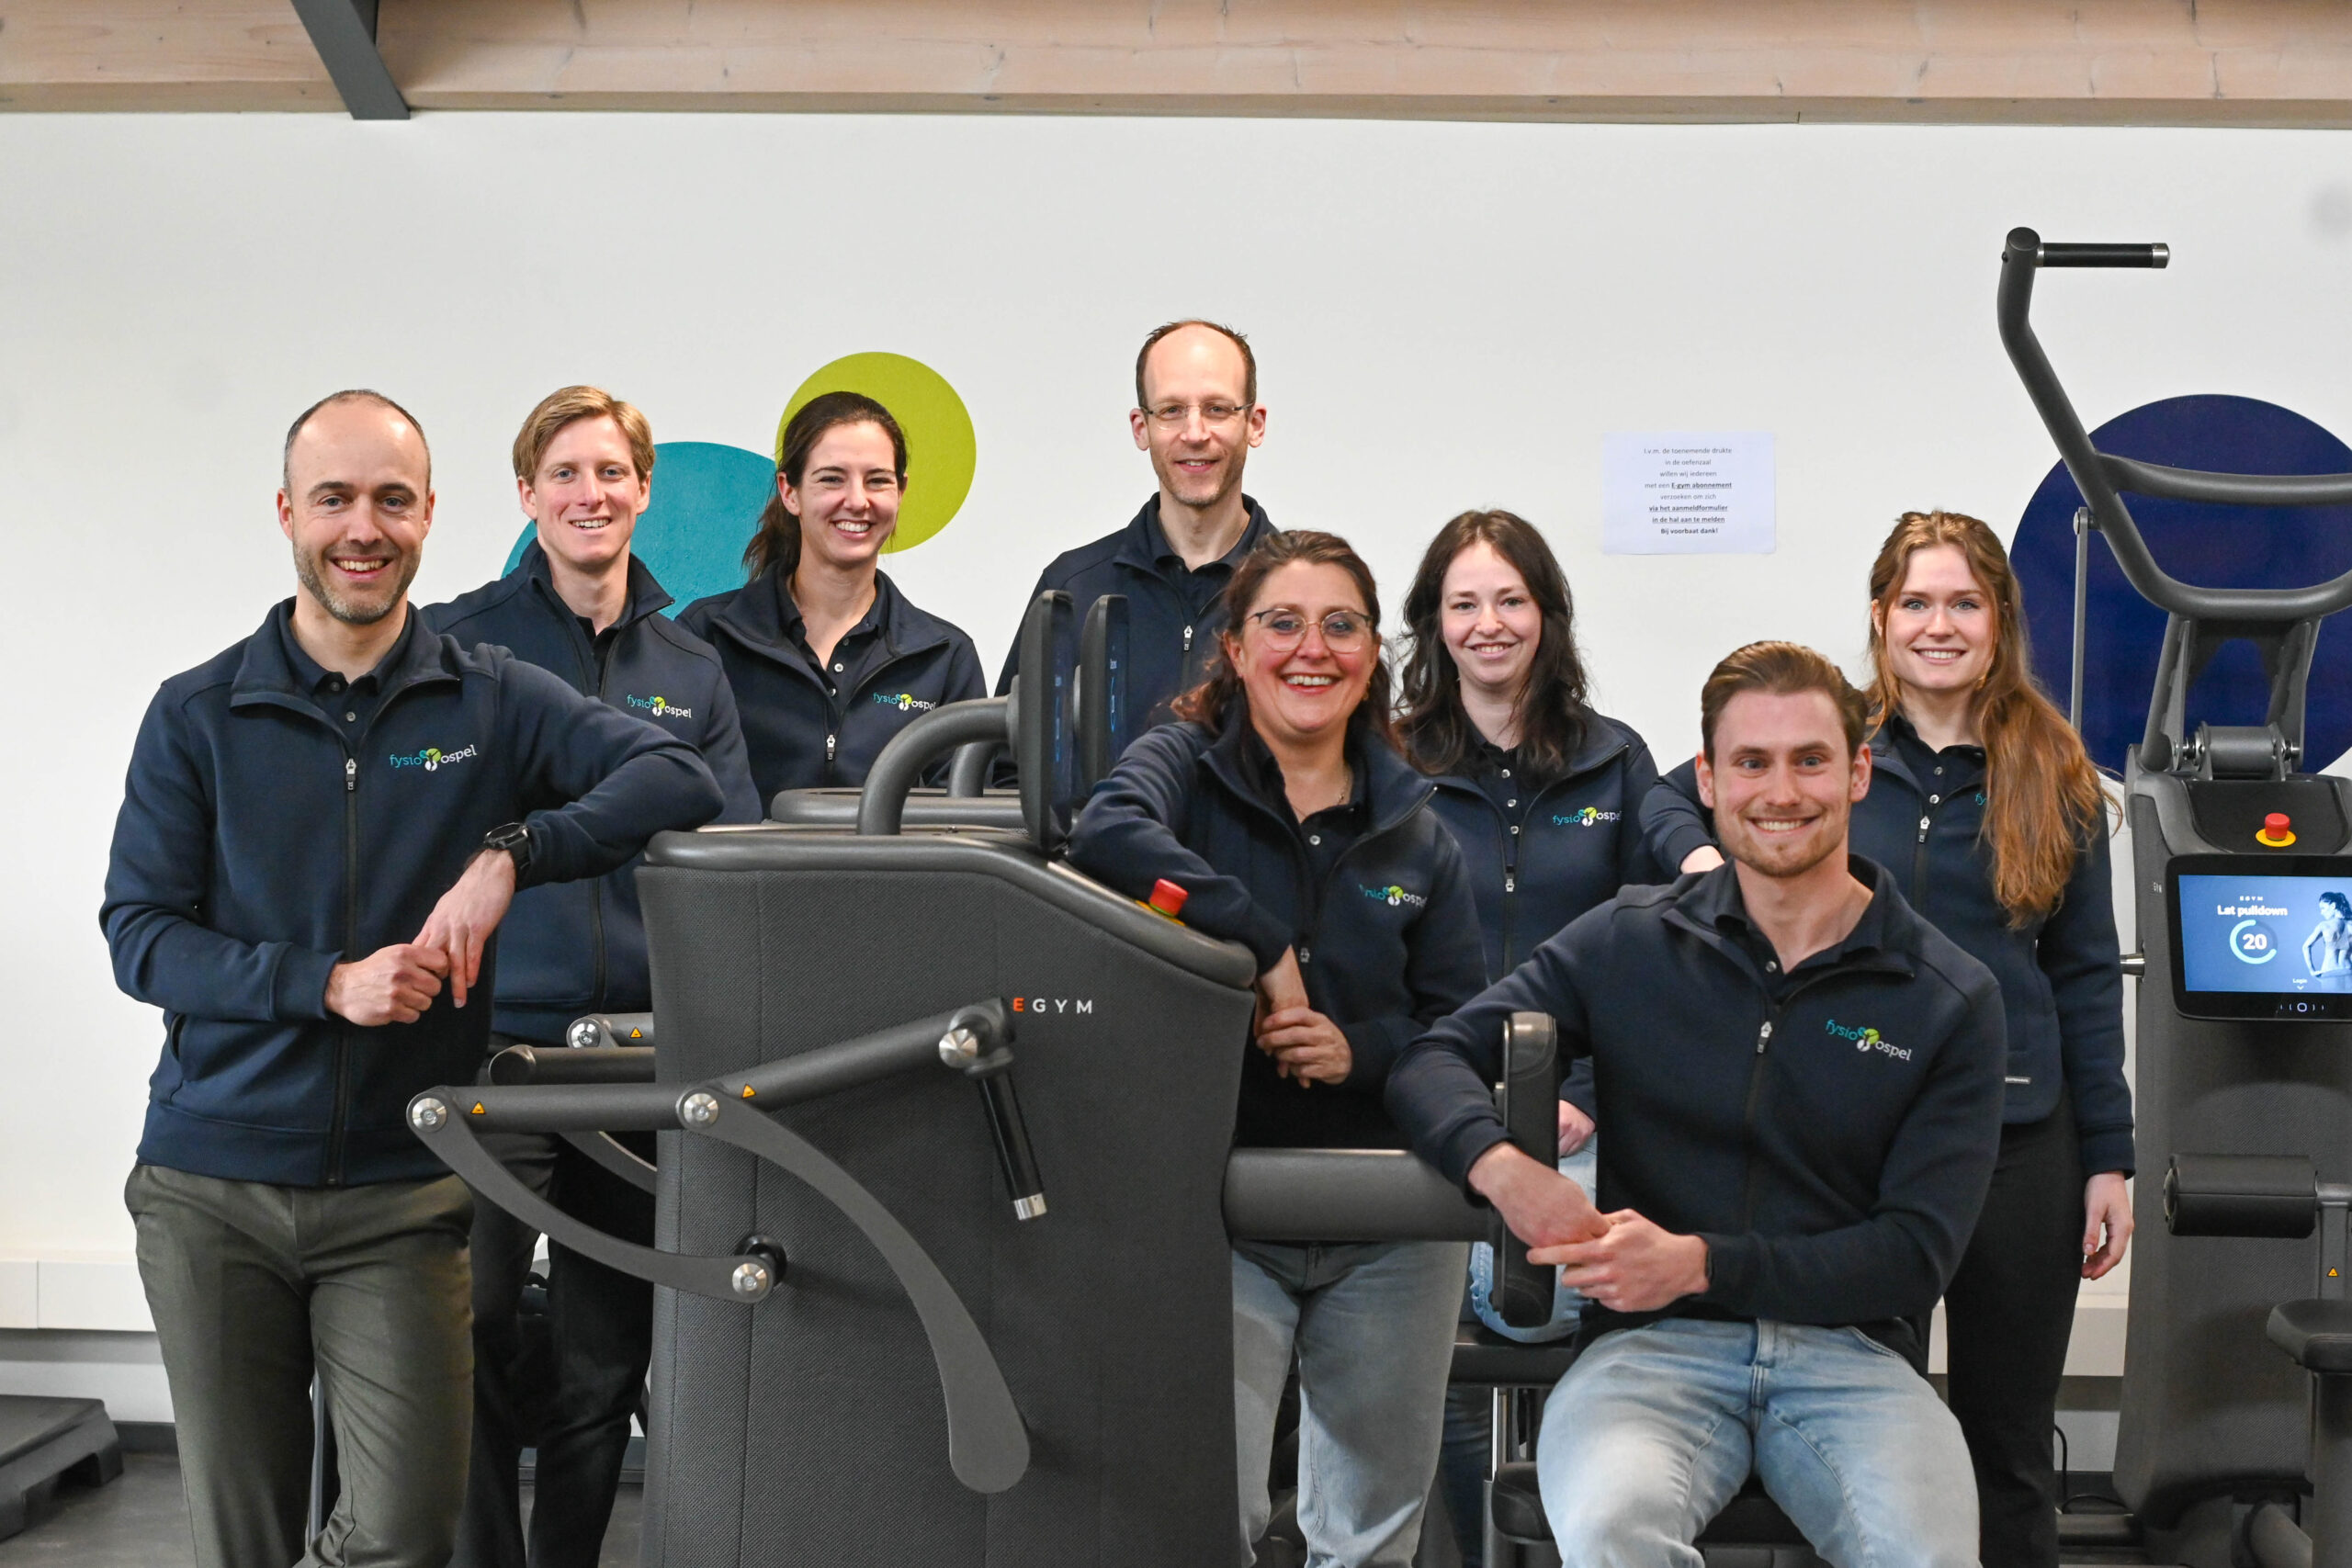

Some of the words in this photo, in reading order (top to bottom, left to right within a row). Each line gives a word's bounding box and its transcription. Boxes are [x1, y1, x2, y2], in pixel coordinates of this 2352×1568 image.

[1679, 470, 1689, 479] wij
[389, 753, 423, 769] fysio
[1553, 815, 1580, 826] fysio
[2217, 905, 2236, 916] Lat
[2237, 905, 2289, 918] pulldown
[2243, 933, 2267, 950] 20
[1012, 997, 1092, 1014] EGYM
[1826, 1019, 1858, 1041] fysio
